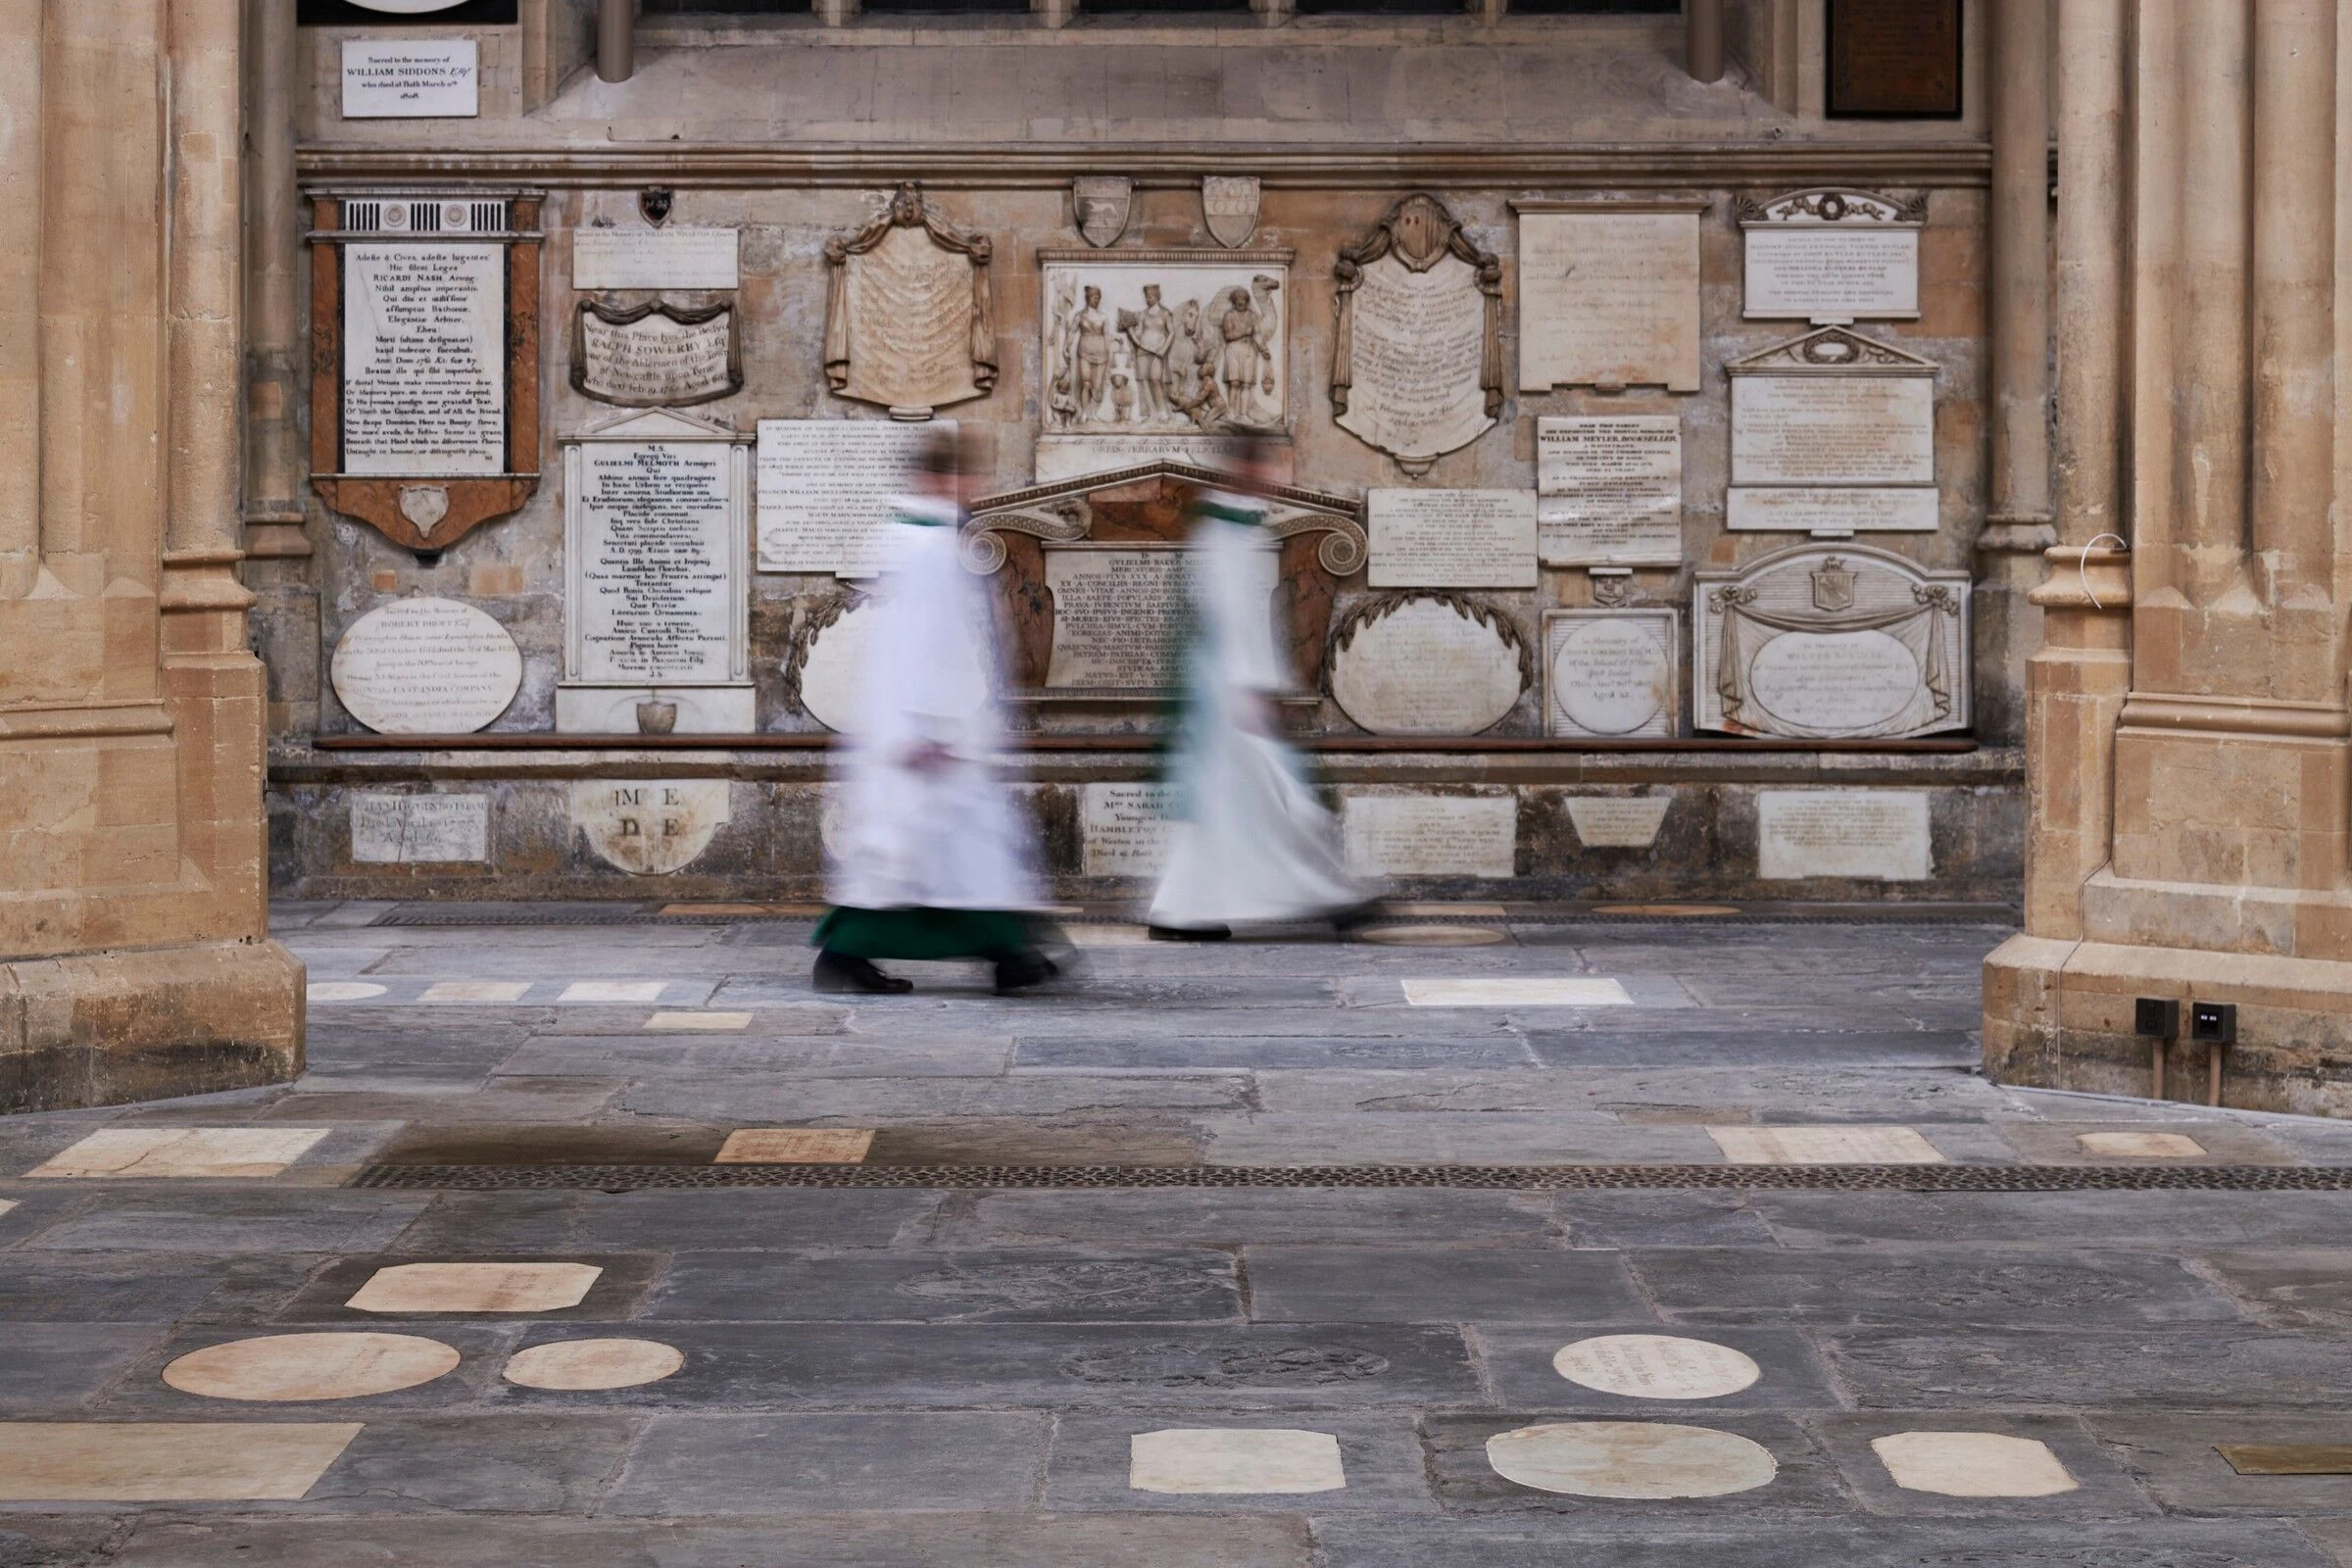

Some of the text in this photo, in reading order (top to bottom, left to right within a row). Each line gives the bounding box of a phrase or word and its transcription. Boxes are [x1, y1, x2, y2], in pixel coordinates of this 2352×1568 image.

[632, 332, 658, 342] Place
[592, 339, 700, 355] RALPH SOWERBY
[662, 788, 680, 806] E
[663, 818, 679, 837] E
